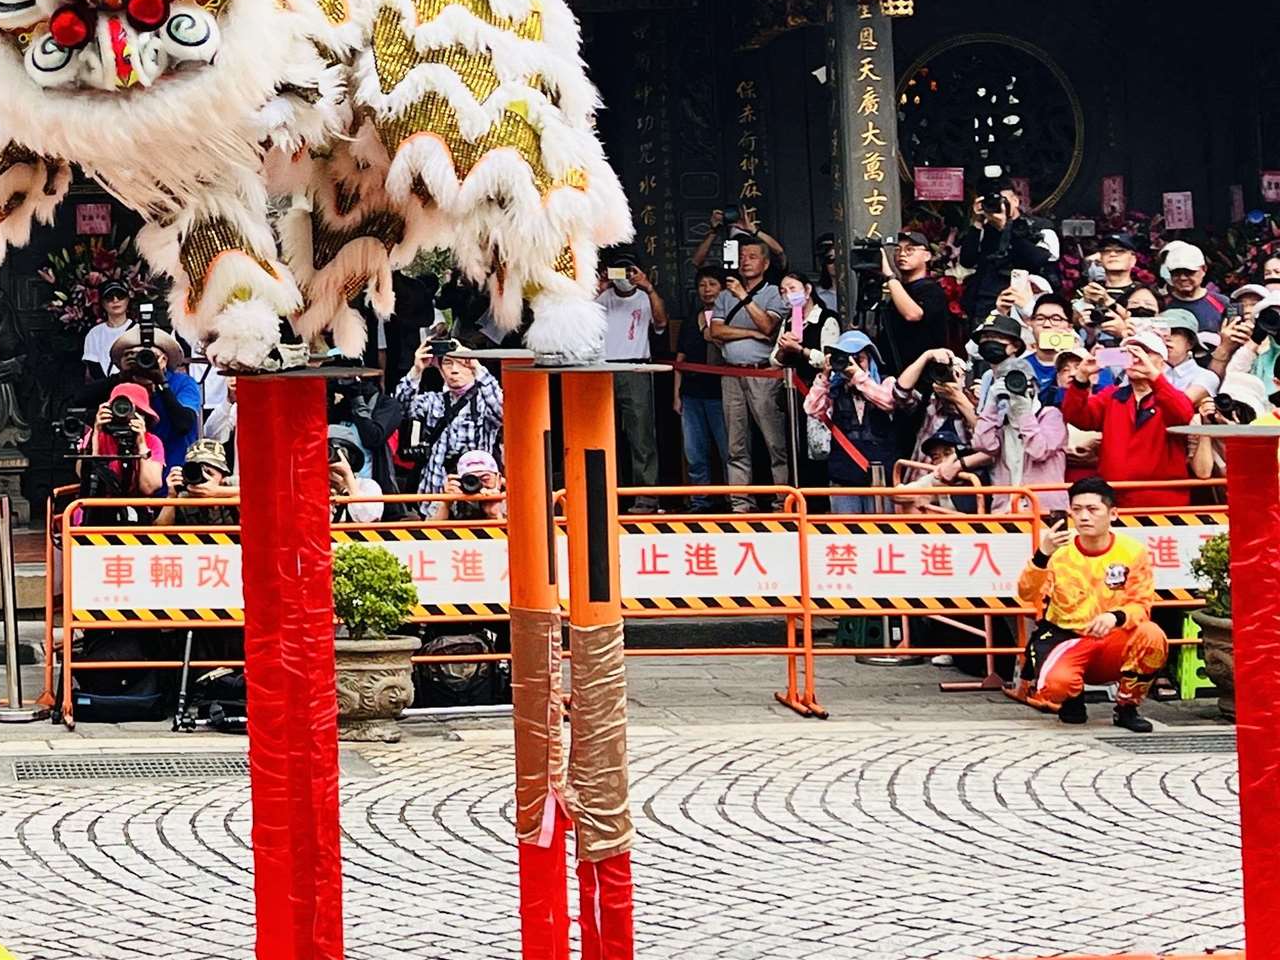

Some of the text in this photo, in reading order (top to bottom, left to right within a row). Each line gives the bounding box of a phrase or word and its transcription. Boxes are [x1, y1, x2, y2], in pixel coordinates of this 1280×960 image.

[407, 548, 509, 582] 止進
[637, 542, 767, 576] 止進入
[825, 543, 1001, 576] 禁止進入
[1148, 535, 1210, 568] 進
[102, 554, 230, 588] 車輛改
